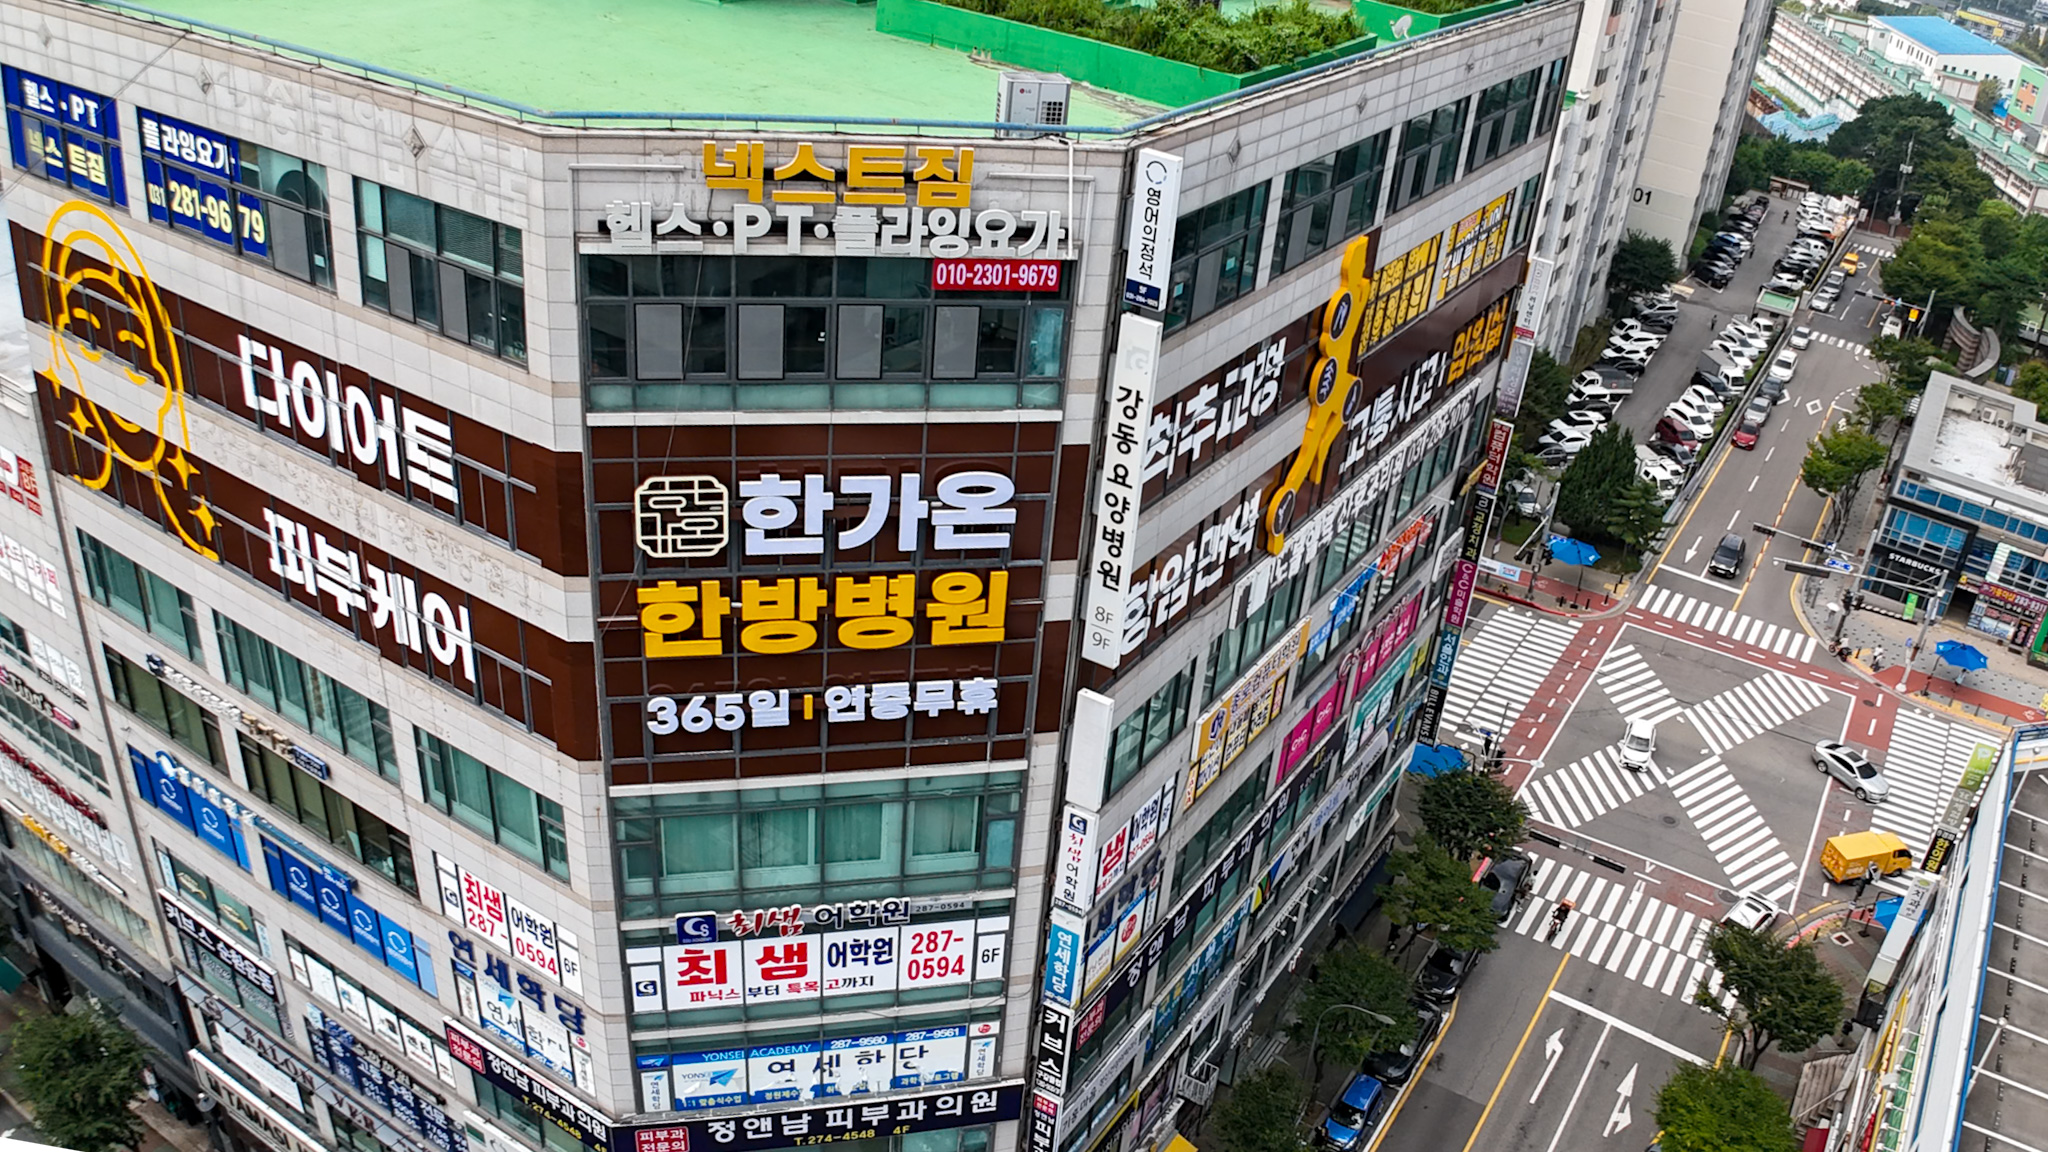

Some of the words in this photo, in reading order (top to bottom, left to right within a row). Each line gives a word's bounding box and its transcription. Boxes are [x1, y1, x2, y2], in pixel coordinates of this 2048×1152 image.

[27, 128, 107, 186] 넥스트짐
[142, 117, 236, 175] 플라잉요가
[702, 139, 975, 208] 넥스트짐
[148, 181, 166, 208] 031
[1139, 187, 1161, 281] 영어의정석
[936, 262, 1058, 288] 010-2301-9679
[1446, 297, 1509, 386] 입원실
[237, 334, 459, 504] 다이어트
[1143, 337, 1288, 485] 척추교정
[1096, 385, 1145, 592] 강동요양병원
[1337, 453, 1408, 533] 산후조리원
[739, 470, 1017, 556] 한가온
[1120, 488, 1262, 655] 항암면역
[1888, 552, 1942, 577] STARBUCKS
[263, 507, 476, 683] 피부케어
[636, 570, 1009, 659] 한방병원
[1094, 606, 1115, 626] 8F
[1091, 631, 1111, 651] 9F
[1437, 633, 1456, 675] 서울안과
[647, 688, 790, 735] 365일
[824, 677, 998, 723] 연중무휴
[1102, 826, 1127, 877] 샘
[1925, 837, 1950, 874] 한의원
[1063, 863, 1079, 902] 어학원
[1907, 889, 1926, 909] 치과
[464, 873, 504, 924] 최샘
[511, 906, 556, 950] 어학원
[726, 904, 804, 938] 최샘
[813, 897, 911, 930] 어학원
[915, 902, 966, 913] 287-0594
[165, 902, 215, 950] 커브스
[217, 942, 275, 996] 순환운동
[564, 957, 578, 978] 6F
[827, 936, 894, 968] 어학원
[907, 955, 966, 983] 0594
[981, 946, 1001, 965] 6F
[1051, 931, 1072, 994] 연세학당
[448, 930, 587, 1036] 연세학당
[450, 1031, 481, 1060] 피부과
[702, 1050, 745, 1062] YONSEI
[750, 1044, 812, 1058] ACADEMY
[831, 1035, 888, 1050] 287-9560
[905, 1027, 960, 1043] 287-9561
[1039, 1010, 1067, 1077] 커브스
[451, 1043, 482, 1071] 전문의
[486, 1050, 530, 1093] 정앤남
[532, 1080, 608, 1142] 피부과의원
[708, 1113, 813, 1143] 정앤남
[825, 1090, 998, 1130] 피부과의원
[640, 1129, 685, 1142] 피부과
[640, 1141, 686, 1152] 전문의
[893, 1125, 911, 1136] 4F
[1032, 1120, 1052, 1152] 피부
